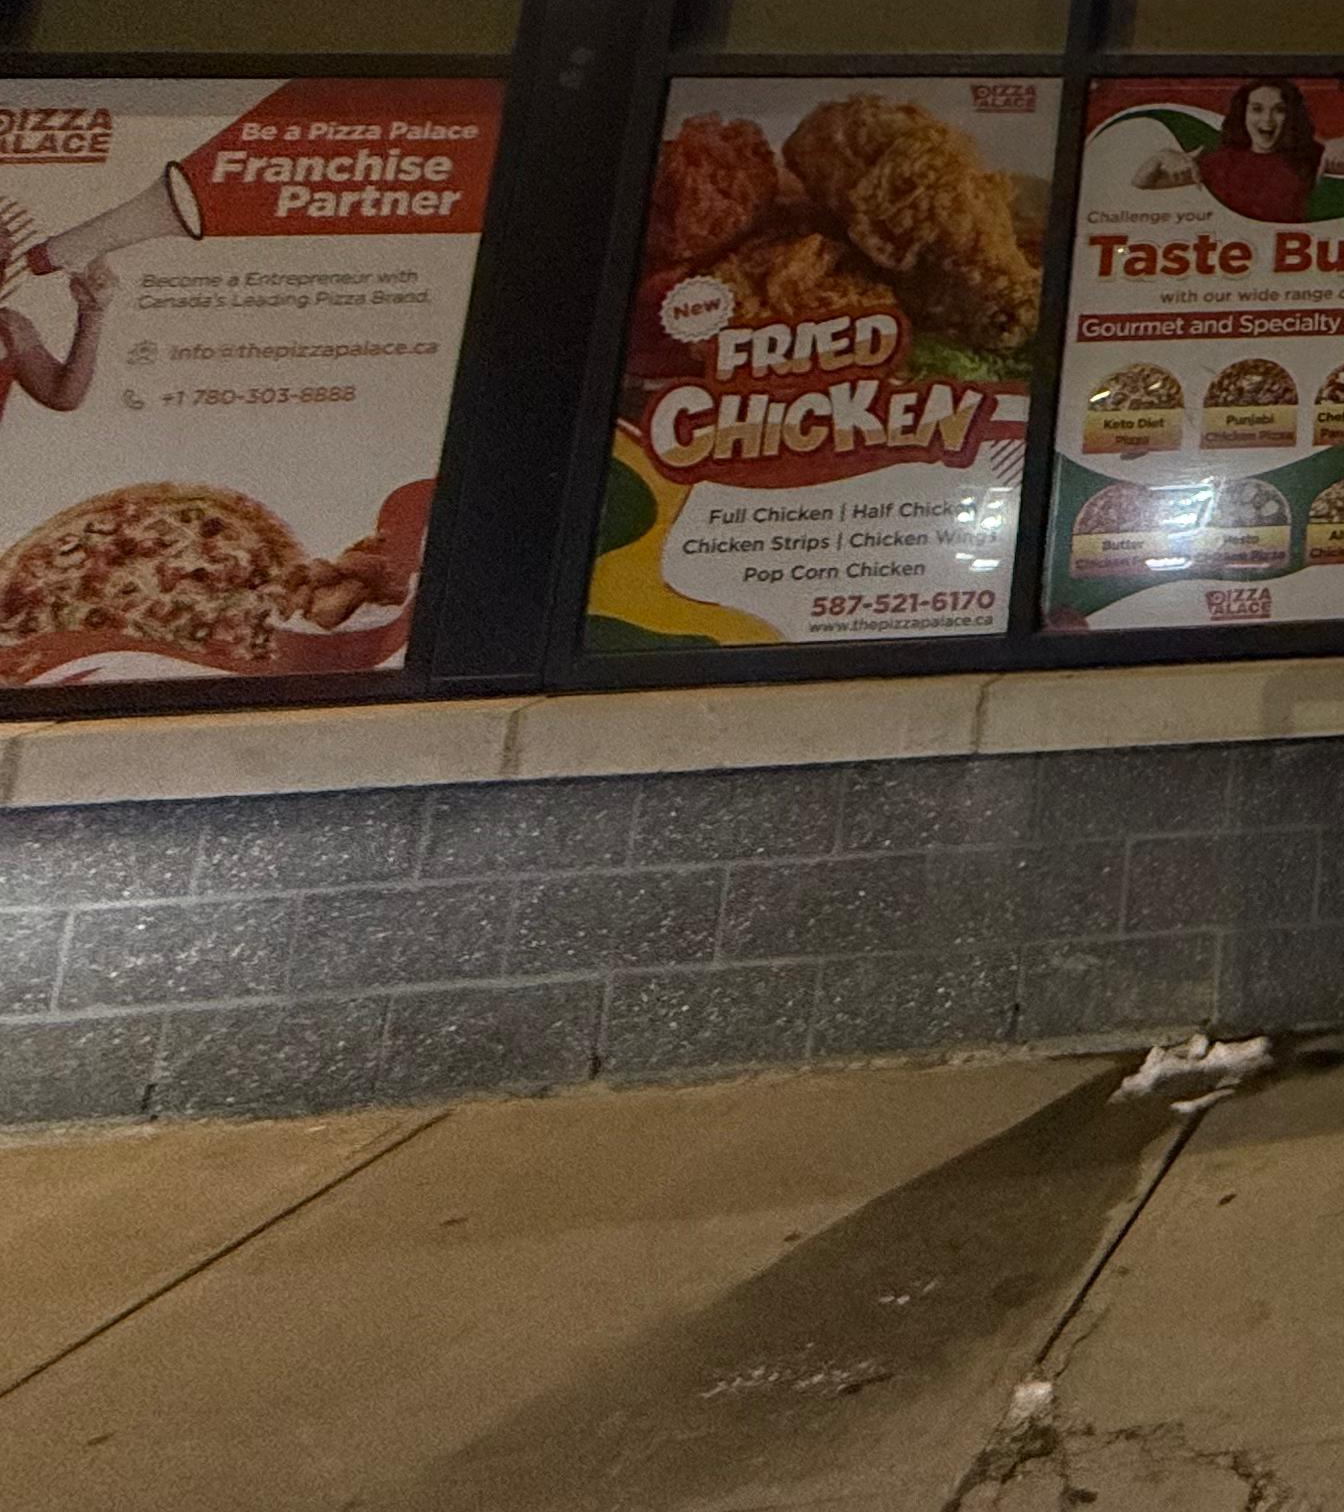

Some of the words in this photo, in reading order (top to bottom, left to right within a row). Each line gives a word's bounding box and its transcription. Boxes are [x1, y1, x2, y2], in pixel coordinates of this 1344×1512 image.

[242, 122, 277, 141] Be
[284, 126, 301, 141] a
[308, 121, 382, 141] Pizza
[389, 120, 479, 140] Palace
[212, 148, 453, 183] Franchise
[274, 185, 462, 217] Partner
[1087, 210, 1171, 226] Challenge
[1175, 210, 1213, 225] your
[1088, 233, 1254, 279] Taste
[142, 273, 223, 288] Become
[227, 275, 239, 287] a
[244, 271, 372, 290] Entrepreneur
[376, 270, 419, 285] with
[138, 292, 225, 310] Canada's
[231, 291, 308, 309] Leading
[313, 290, 366, 306] Pizza
[1161, 289, 1198, 304] with
[1204, 291, 1232, 302] our
[1239, 287, 1279, 302] wide
[1284, 289, 1333, 304] range
[673, 295, 720, 321] New
[1082, 317, 1184, 337] Gourmet
[1190, 315, 1233, 334] and
[1240, 313, 1341, 337] Specialty
[715, 314, 898, 380] FRIED
[650, 381, 981, 468] CHICKEN
[1103, 418, 1136, 430] Keto
[1138, 417, 1164, 429] Diet
[1226, 413, 1274, 428] Punjabi
[709, 508, 746, 525] Full
[753, 505, 833, 524] Chicken
[853, 502, 895, 519] Half
[900, 501, 976, 519] Chick
[682, 537, 764, 555] Chicken
[771, 535, 830, 552] Strips
[850, 531, 928, 549] Chicken
[743, 567, 784, 584] Pop
[792, 564, 838, 581] Corn
[847, 561, 925, 578] Chicken
[810, 589, 996, 617] 587-521-6170
[809, 614, 994, 634] www.thepizzapalace.ca
